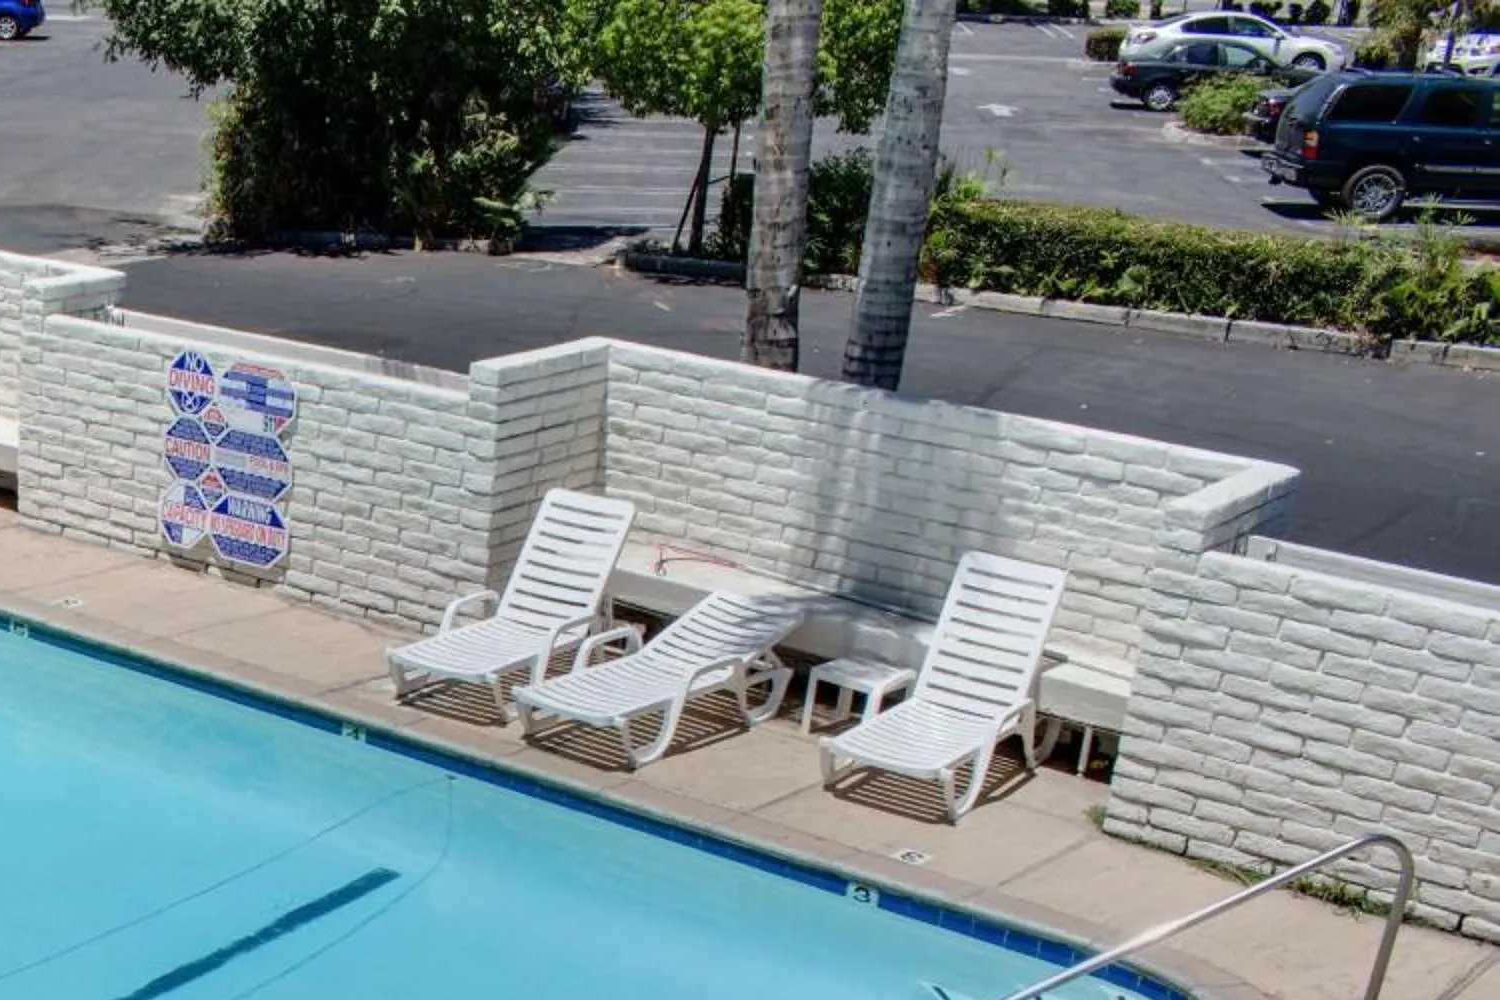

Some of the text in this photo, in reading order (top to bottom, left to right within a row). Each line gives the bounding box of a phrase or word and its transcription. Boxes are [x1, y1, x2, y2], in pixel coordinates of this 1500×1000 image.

[184, 351, 204, 372] NO
[169, 369, 215, 395] DIVING
[165, 437, 211, 462] CAUTION
[162, 501, 209, 529] CAPACITY
[854, 885, 870, 902] 3
